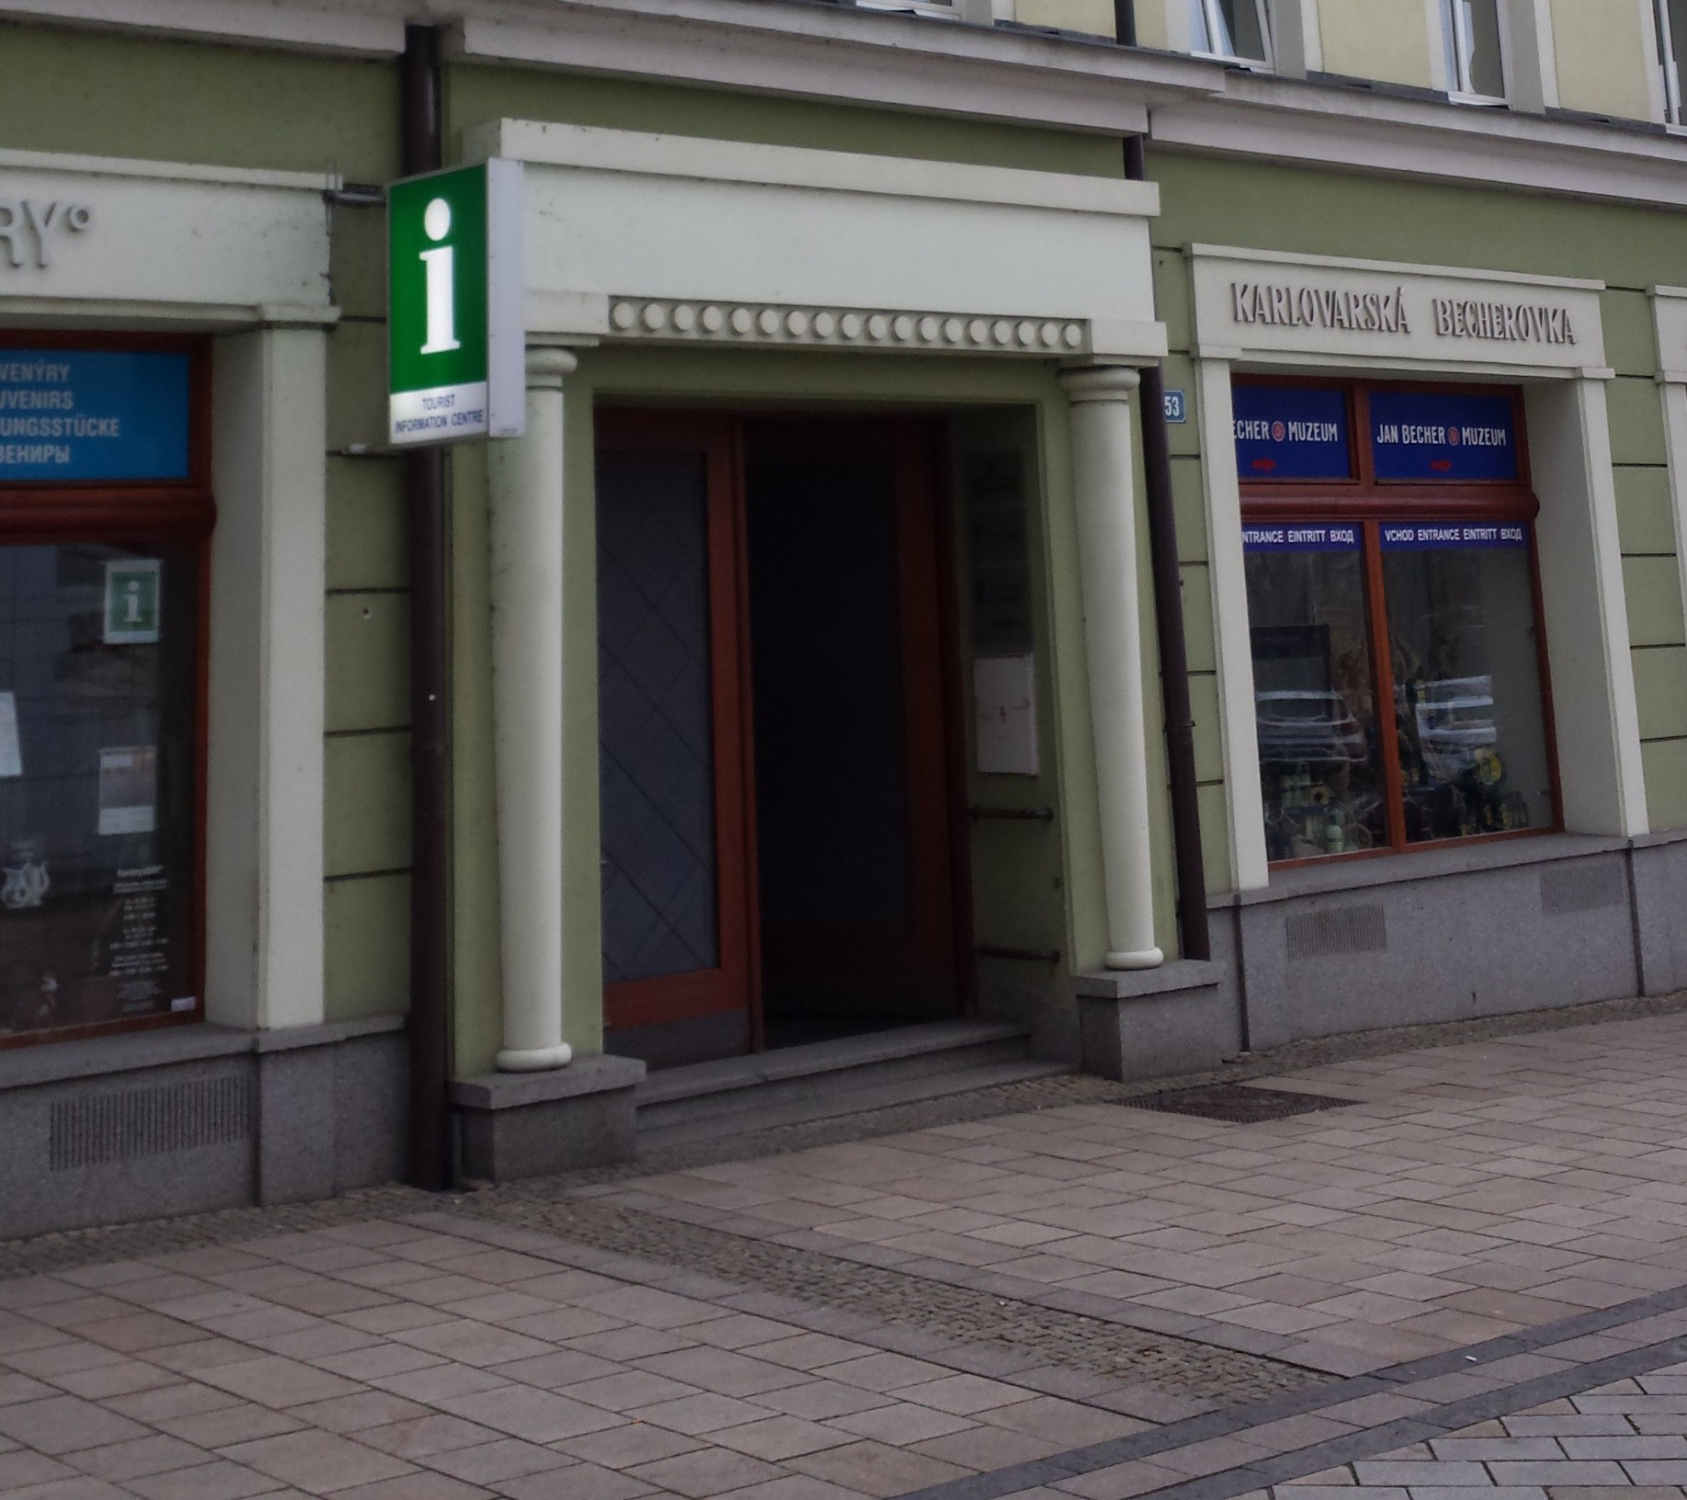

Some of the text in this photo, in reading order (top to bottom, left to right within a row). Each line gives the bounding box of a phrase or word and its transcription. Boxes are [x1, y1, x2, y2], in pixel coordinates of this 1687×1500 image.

[418, 197, 461, 356] i
[1231, 283, 1576, 345] KARLOVARSKÁ BECHEROVKA
[422, 394, 456, 411] TOURIST
[1164, 395, 1180, 417] 53
[394, 409, 483, 433] INFORMATION CENTRE
[1288, 420, 1338, 442] MUZEUM
[1376, 424, 1507, 446] JAN BECHER MUZEUM
[1288, 529, 1326, 543] EINTRITT
[1330, 529, 1354, 544] ВХОД
[1384, 528, 1522, 542] VCHOD ENTRANCE EINTRITT ВХОД
